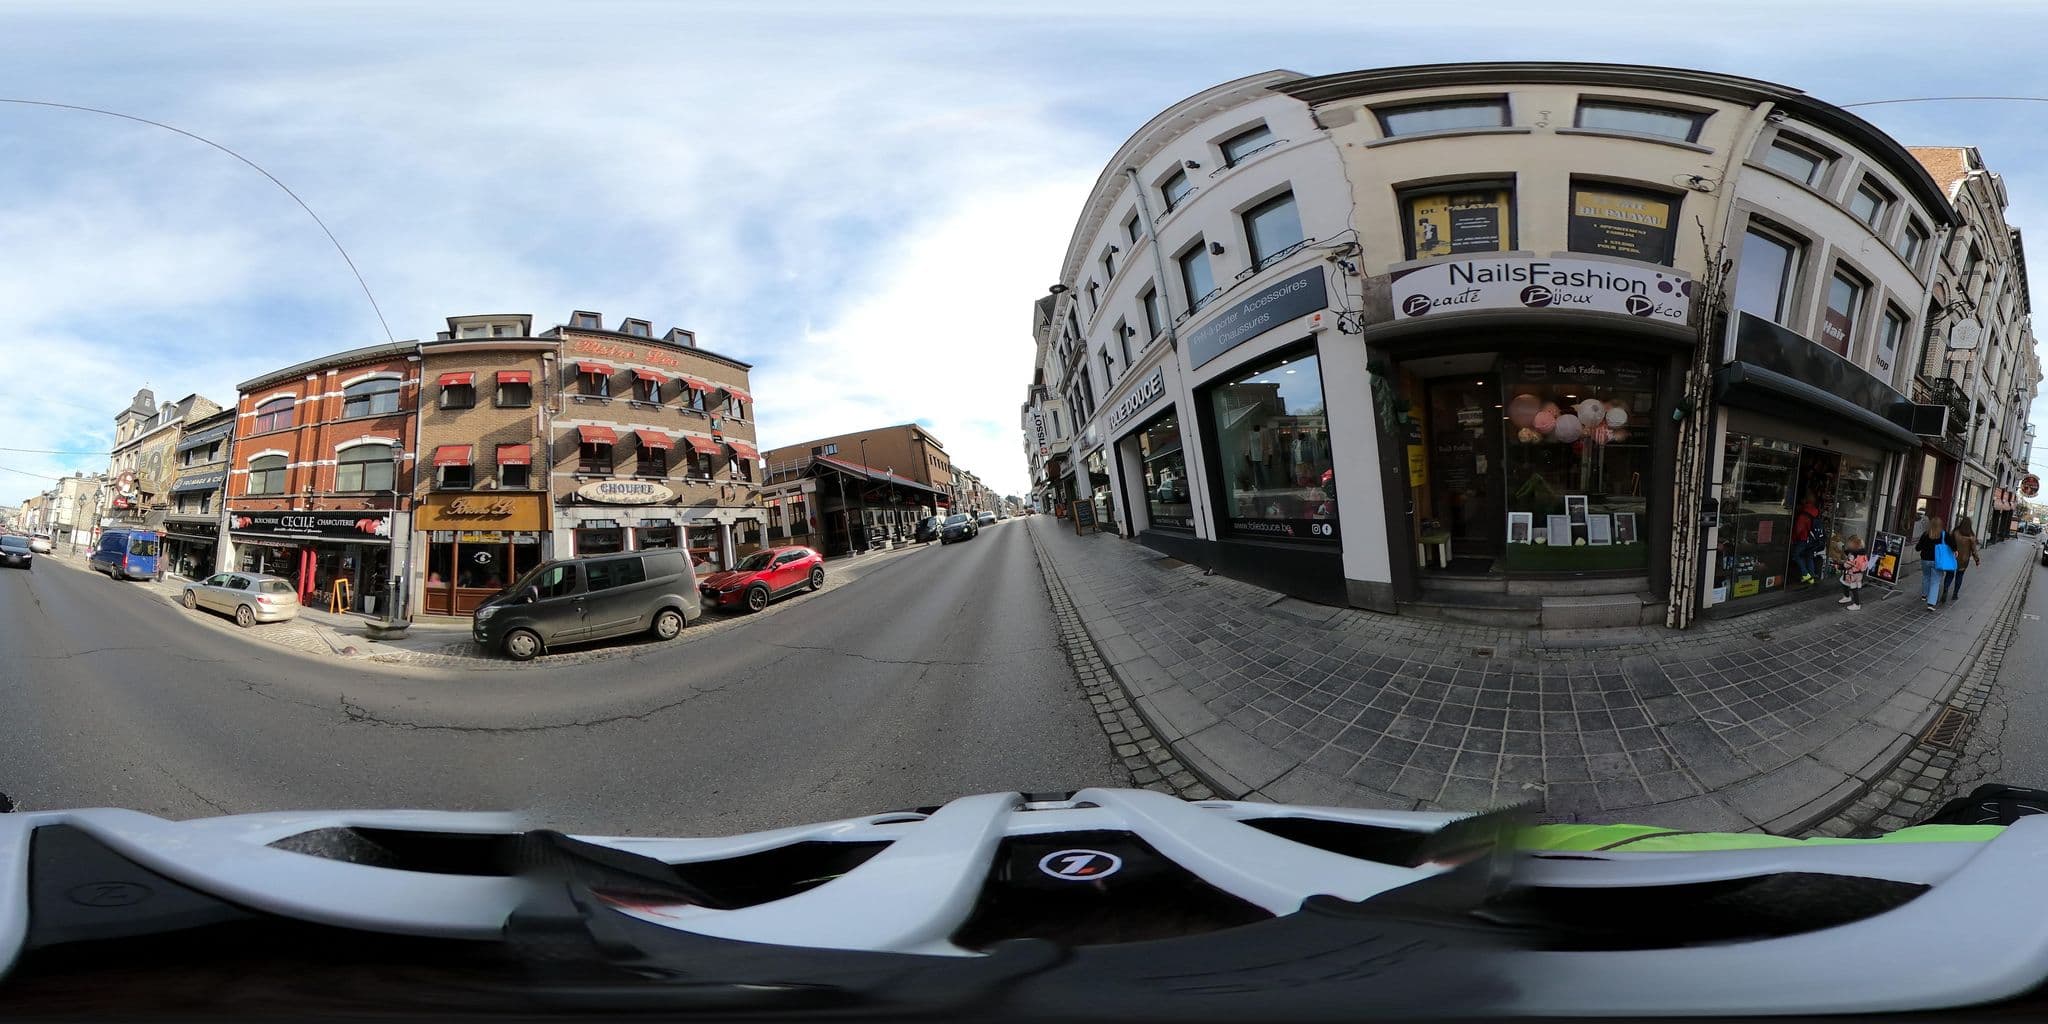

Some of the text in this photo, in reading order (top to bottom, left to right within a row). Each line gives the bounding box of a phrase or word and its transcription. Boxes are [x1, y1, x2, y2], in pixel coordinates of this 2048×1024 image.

[1449, 262, 1648, 295] NailsFashion
[1242, 278, 1309, 315] Accessoires
[1406, 286, 1683, 319] Beauté Bijoux Déco
[1218, 312, 1271, 346] Chaussures
[1822, 320, 1846, 342] Hair
[1033, 413, 1046, 447] TISSOT
[254, 517, 279, 525] BOUCHERIE
[317, 518, 355, 527] CHARCUTERIE
